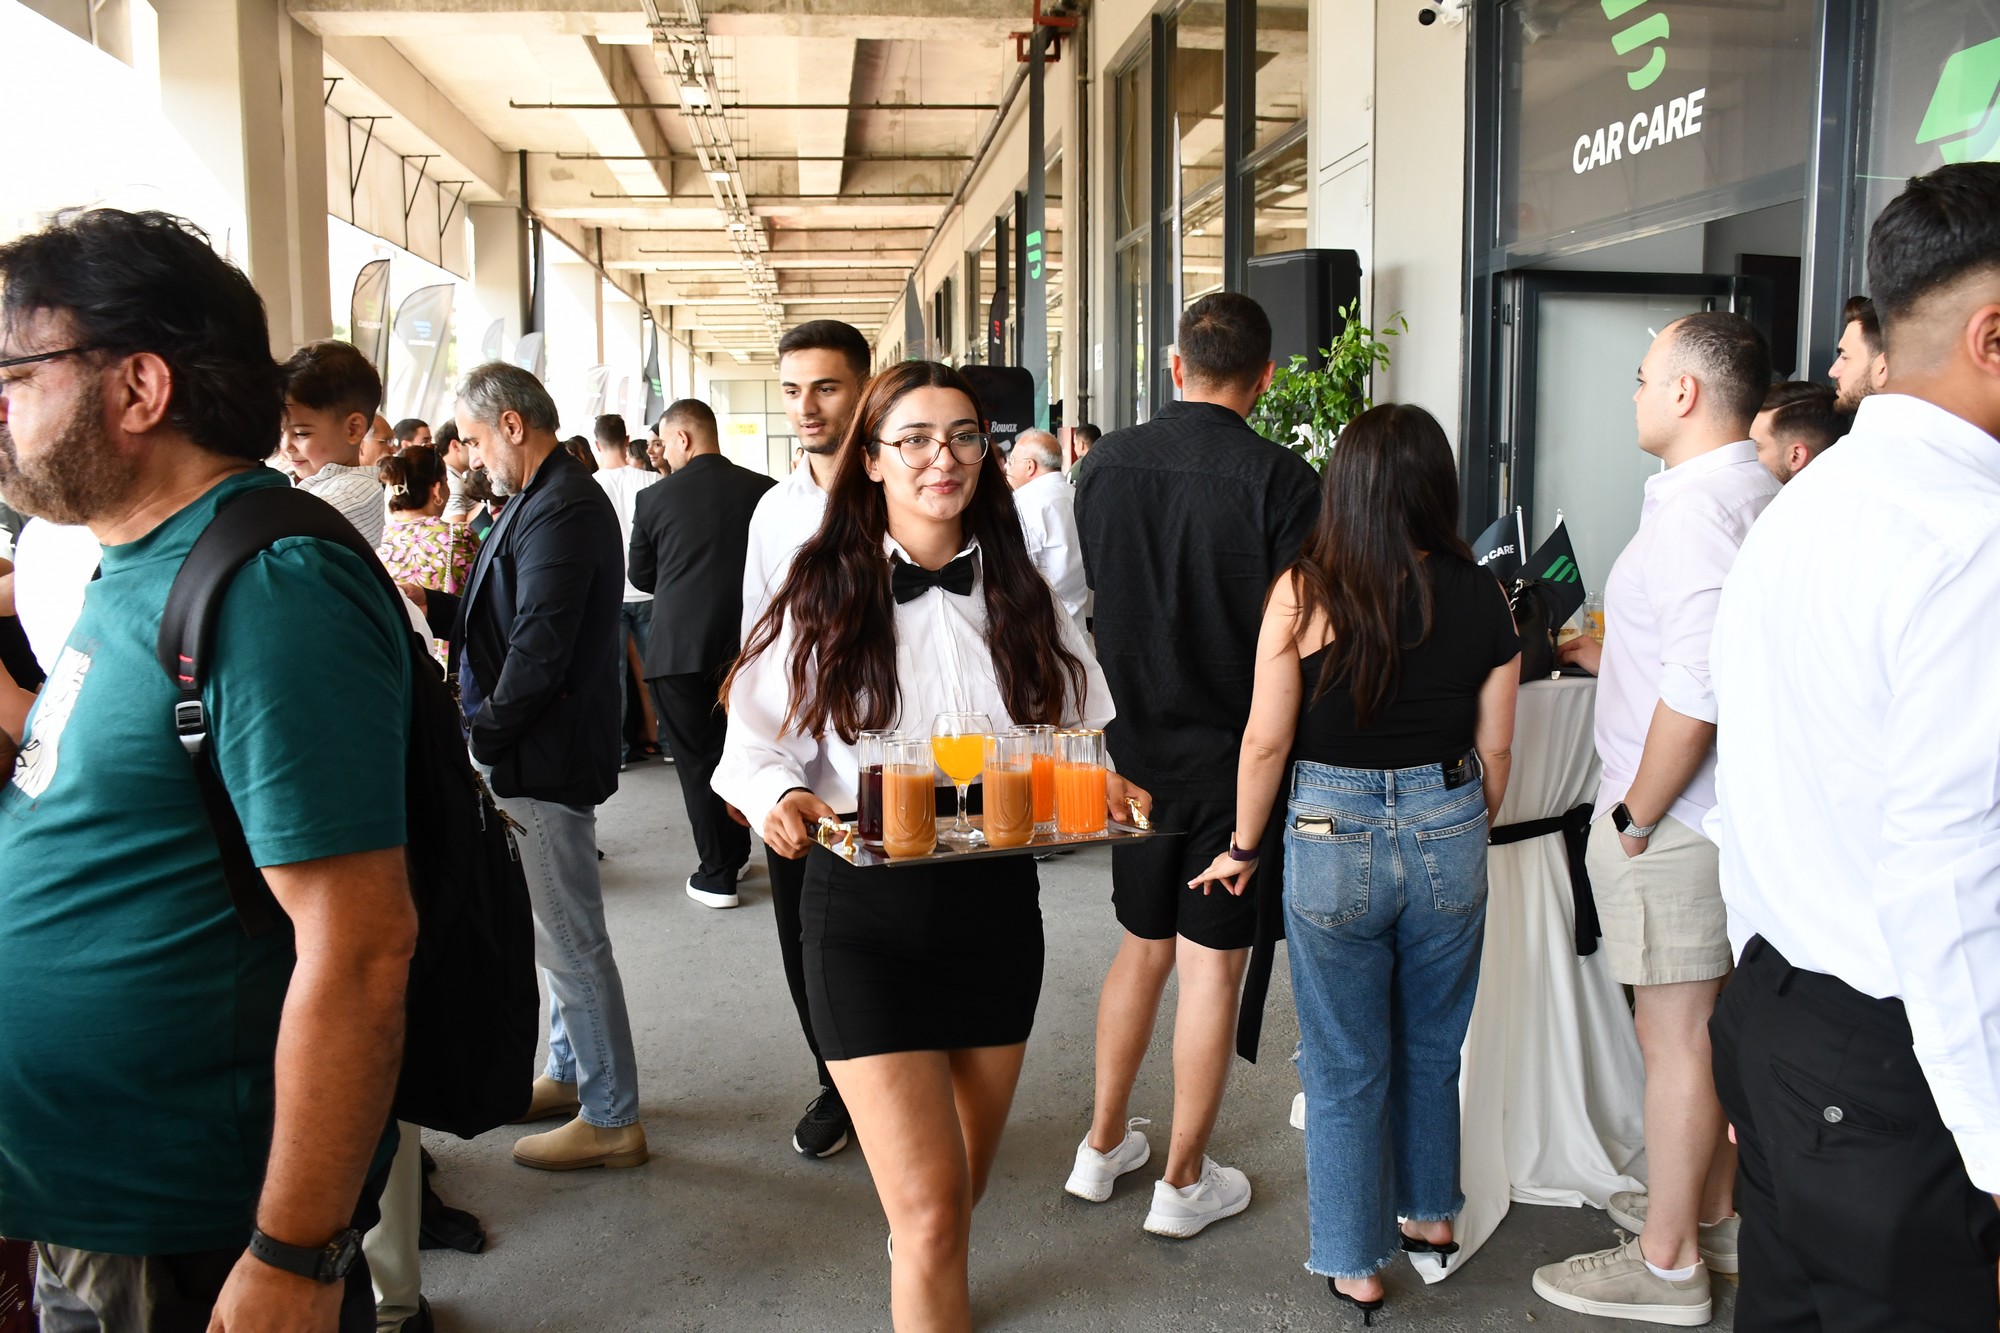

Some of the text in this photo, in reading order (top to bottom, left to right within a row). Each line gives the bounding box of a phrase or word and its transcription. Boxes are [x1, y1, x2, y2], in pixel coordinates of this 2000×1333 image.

[1572, 87, 1706, 174] CAR CARE
[990, 421, 1018, 433] Bowax
[1488, 544, 1515, 560] CARE
